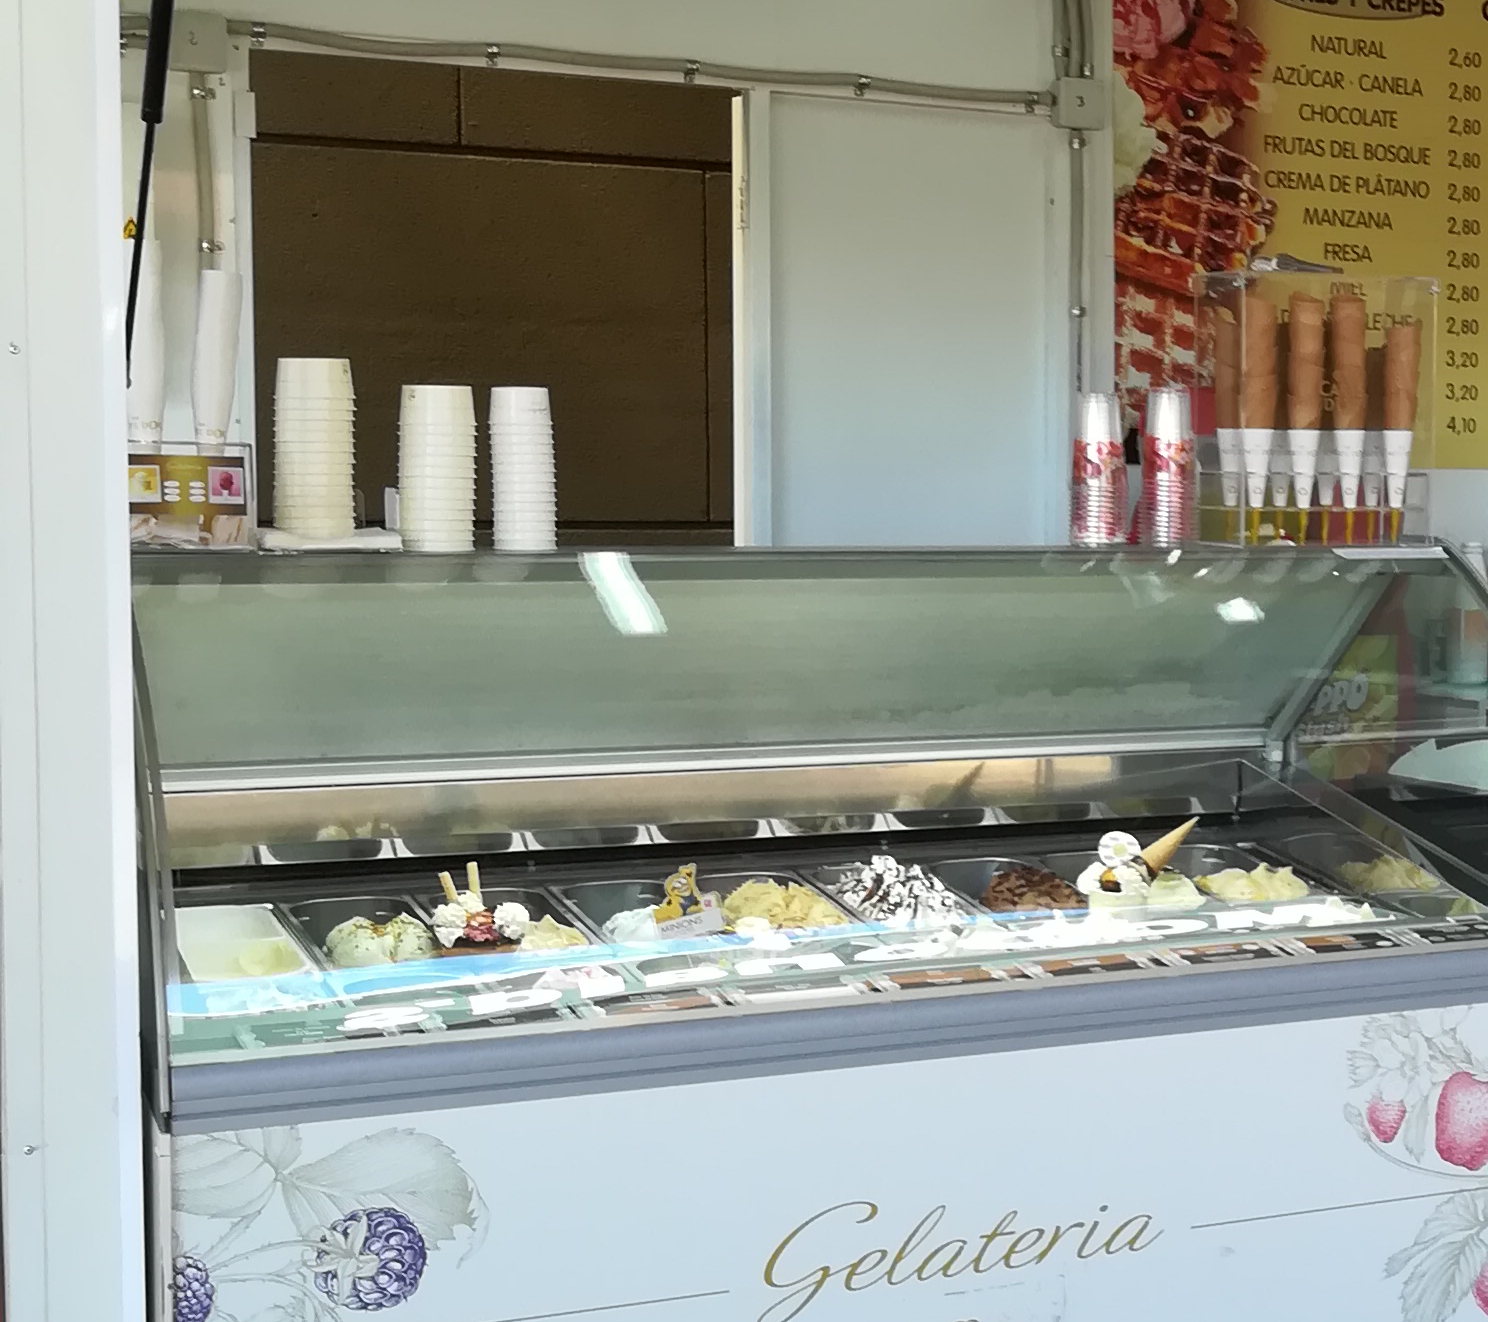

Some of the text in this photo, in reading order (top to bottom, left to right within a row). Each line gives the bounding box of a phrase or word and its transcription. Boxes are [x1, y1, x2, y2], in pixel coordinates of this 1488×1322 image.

[1310, 34, 1388, 60] NATURAL
[1448, 47, 1482, 70] 2,60
[1272, 63, 1424, 97] AZÚCAR CANELA
[1448, 81, 1482, 103] 2,80
[1299, 103, 1398, 130] CHOCOLATE
[1447, 115, 1482, 137] 2,80
[1263, 134, 1432, 166] FRUTAS DEL BOSQUE
[1447, 149, 1481, 171] 2,80
[1264, 169, 1431, 200] CREMA DE PLÁTANO
[1447, 183, 1481, 205] 2,80
[1302, 207, 1394, 231] MANZANA
[1446, 216, 1481, 237] 2,80
[1323, 242, 1373, 263] FRESA
[1446, 250, 1480, 270] 2,80
[1446, 283, 1480, 304] 2,80
[1445, 316, 1480, 337] 2,80
[1445, 350, 1479, 370] 3,20
[1445, 383, 1479, 403] 3,20
[1446, 415, 1477, 436] 4,10
[661, 915, 703, 933] MINIONS
